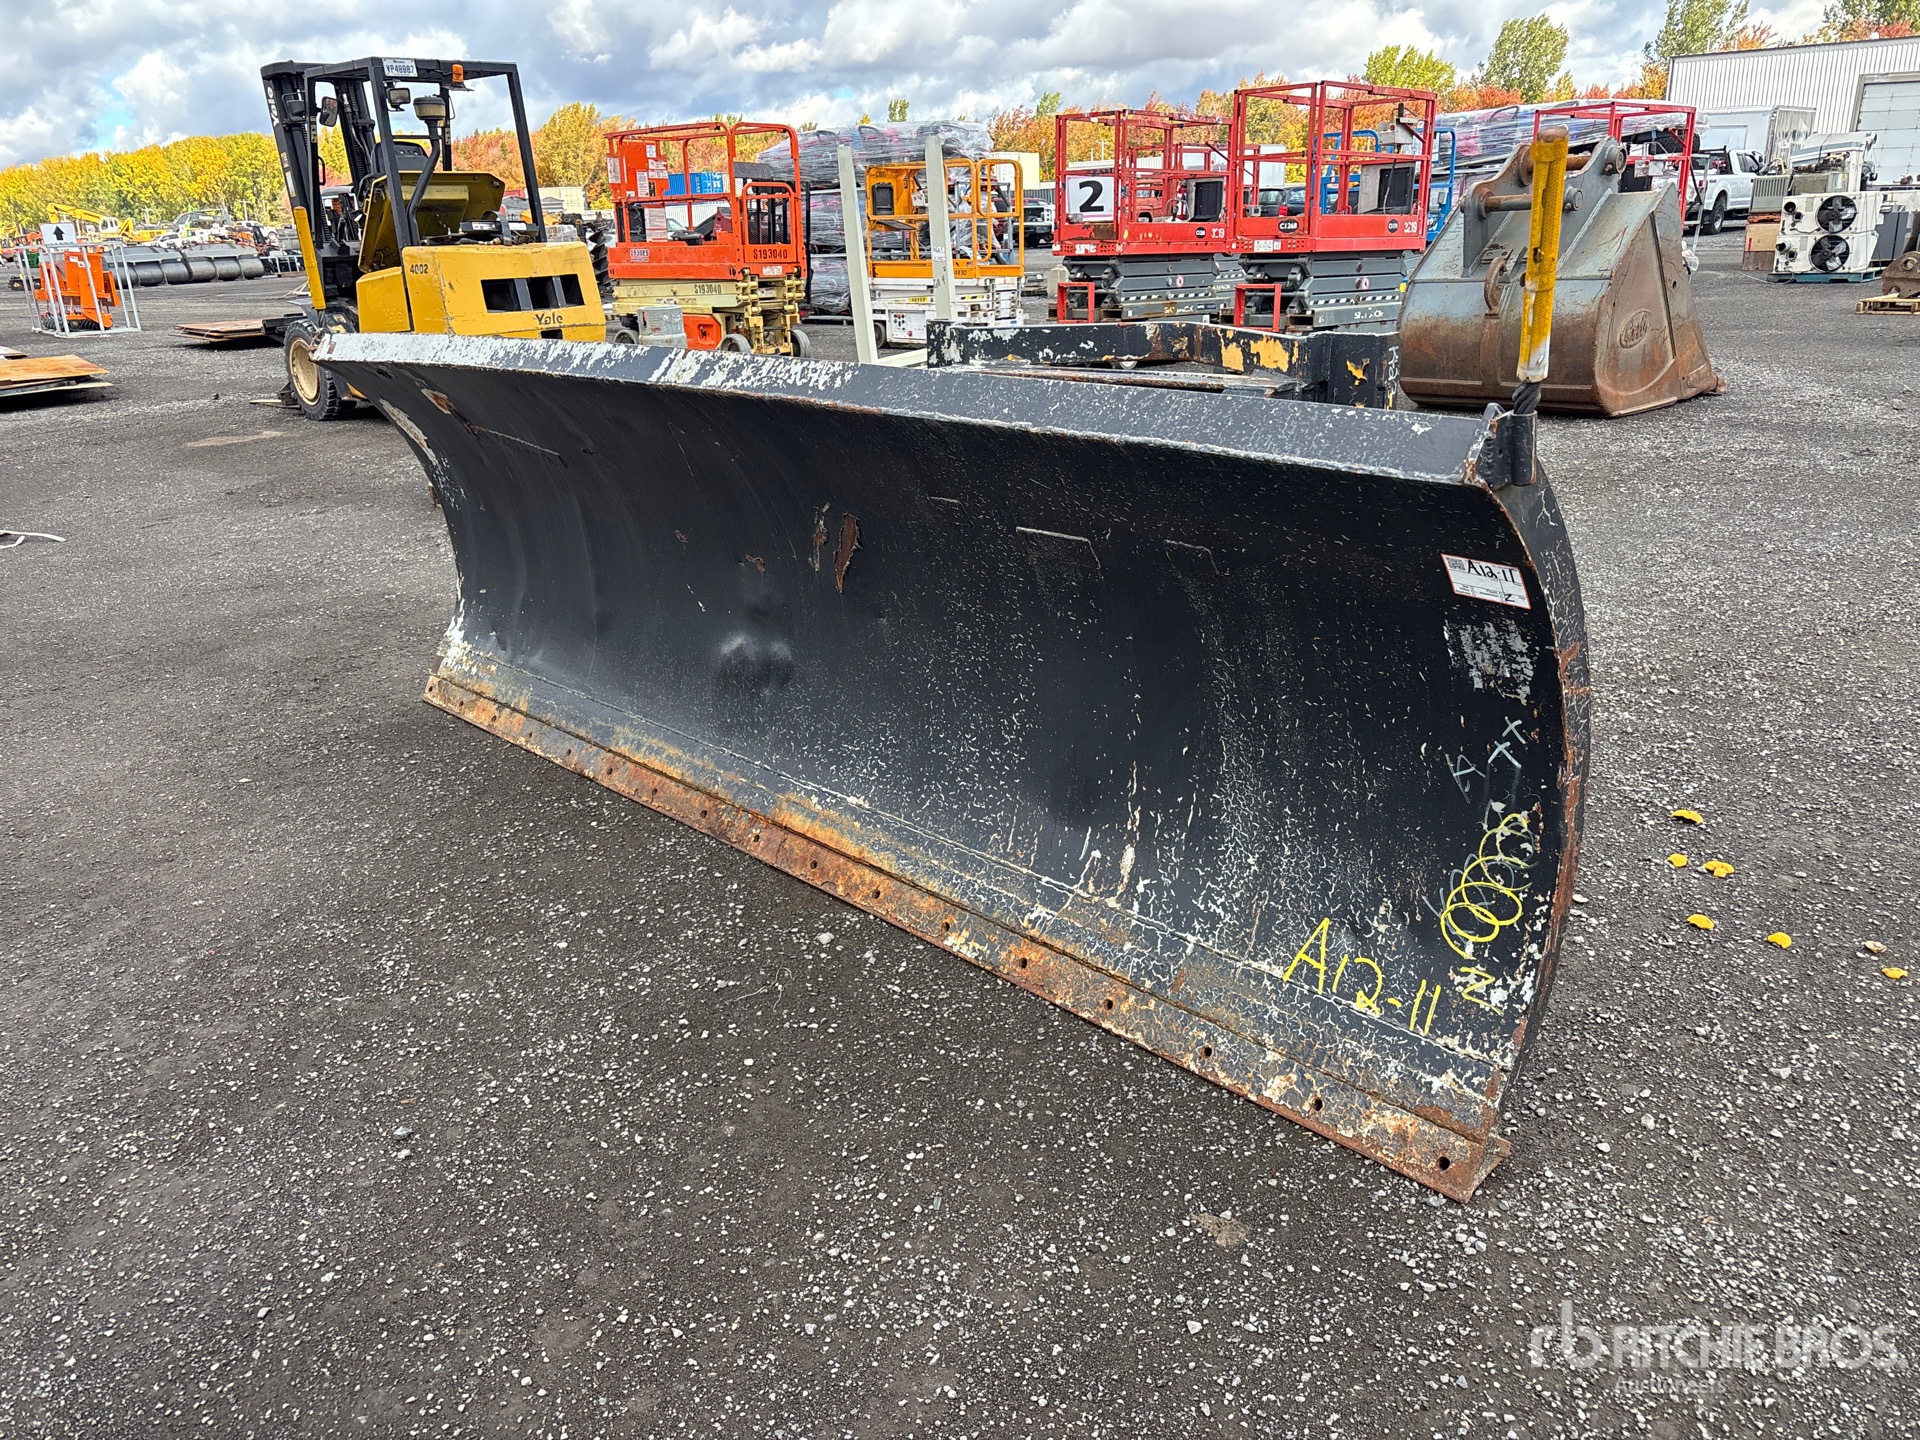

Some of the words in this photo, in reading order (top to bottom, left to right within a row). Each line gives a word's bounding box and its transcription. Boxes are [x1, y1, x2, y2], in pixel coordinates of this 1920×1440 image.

[267, 86, 280, 128] Yale
[1079, 180, 1104, 213] 2
[753, 249, 788, 259] S193040
[410, 264, 429, 274] 4002
[694, 284, 722, 294] S193040
[535, 311, 563, 326] Yale
[1283, 917, 1441, 1036] A12-11
